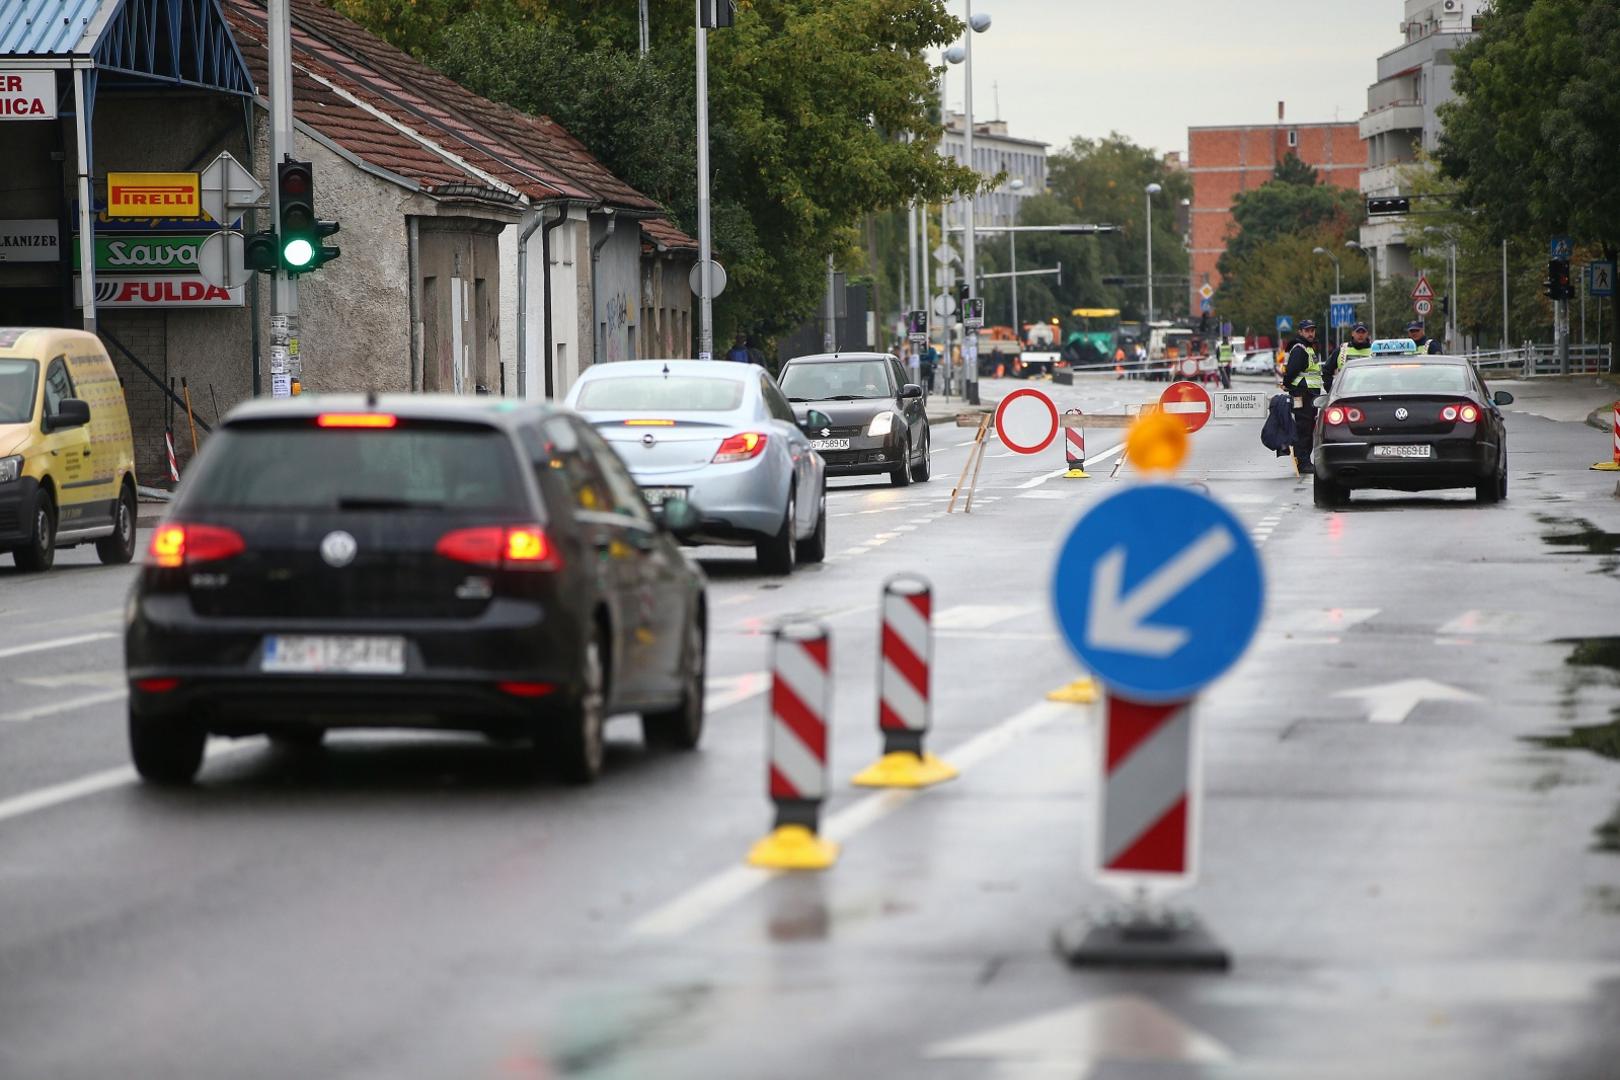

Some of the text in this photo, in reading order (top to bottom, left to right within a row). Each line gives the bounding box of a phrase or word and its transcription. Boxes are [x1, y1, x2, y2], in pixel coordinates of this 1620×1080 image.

[112, 185, 194, 205] PIRELLI
[113, 281, 231, 302] FULDA
[1418, 302, 1428, 311] 40
[1381, 446, 1392, 456] ZG
